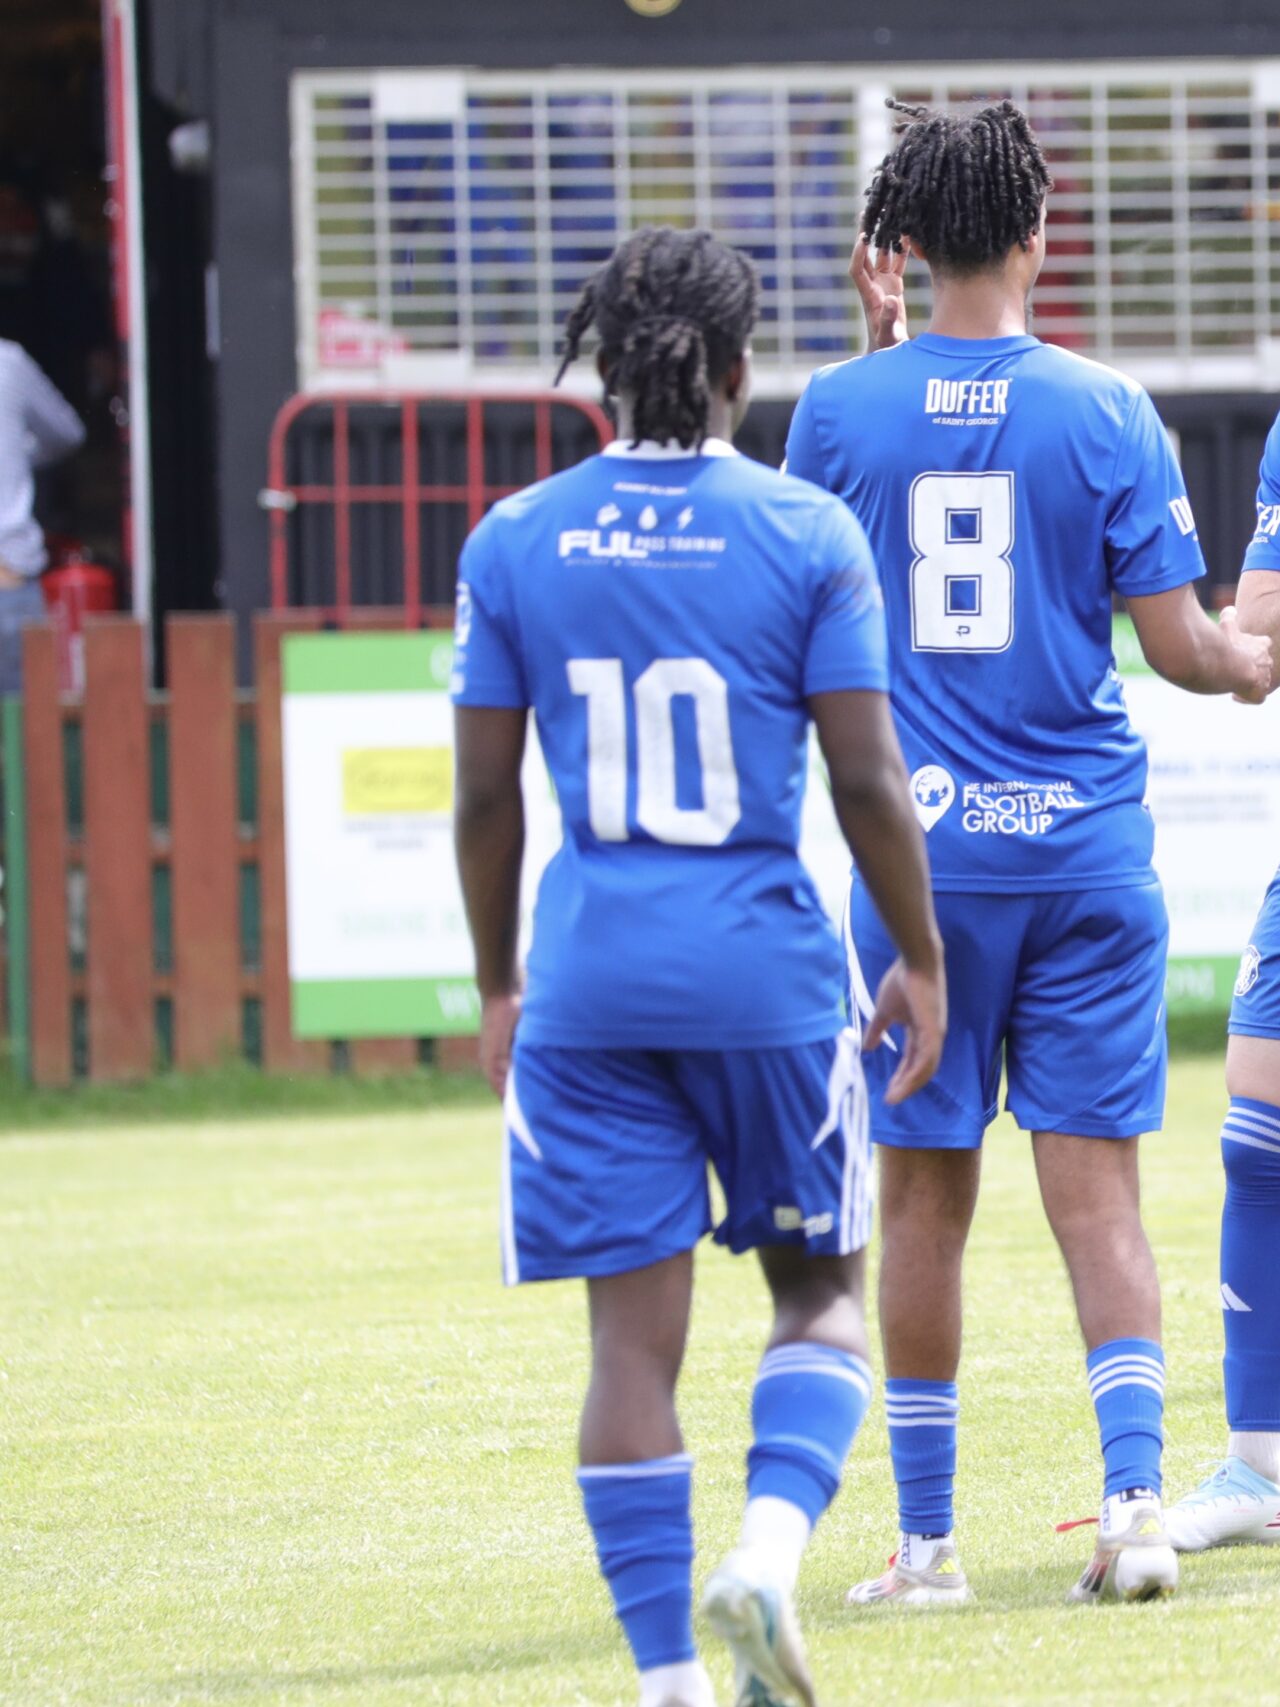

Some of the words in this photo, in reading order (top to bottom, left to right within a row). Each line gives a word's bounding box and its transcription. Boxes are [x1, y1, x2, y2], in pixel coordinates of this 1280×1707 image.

[924, 378, 1010, 415] DUFFER
[558, 529, 649, 559] FUL
[908, 470, 1015, 654] 8
[566, 657, 742, 847] 10
[963, 785, 1085, 815] FOOTBALL
[962, 809, 1053, 836] GROUP
